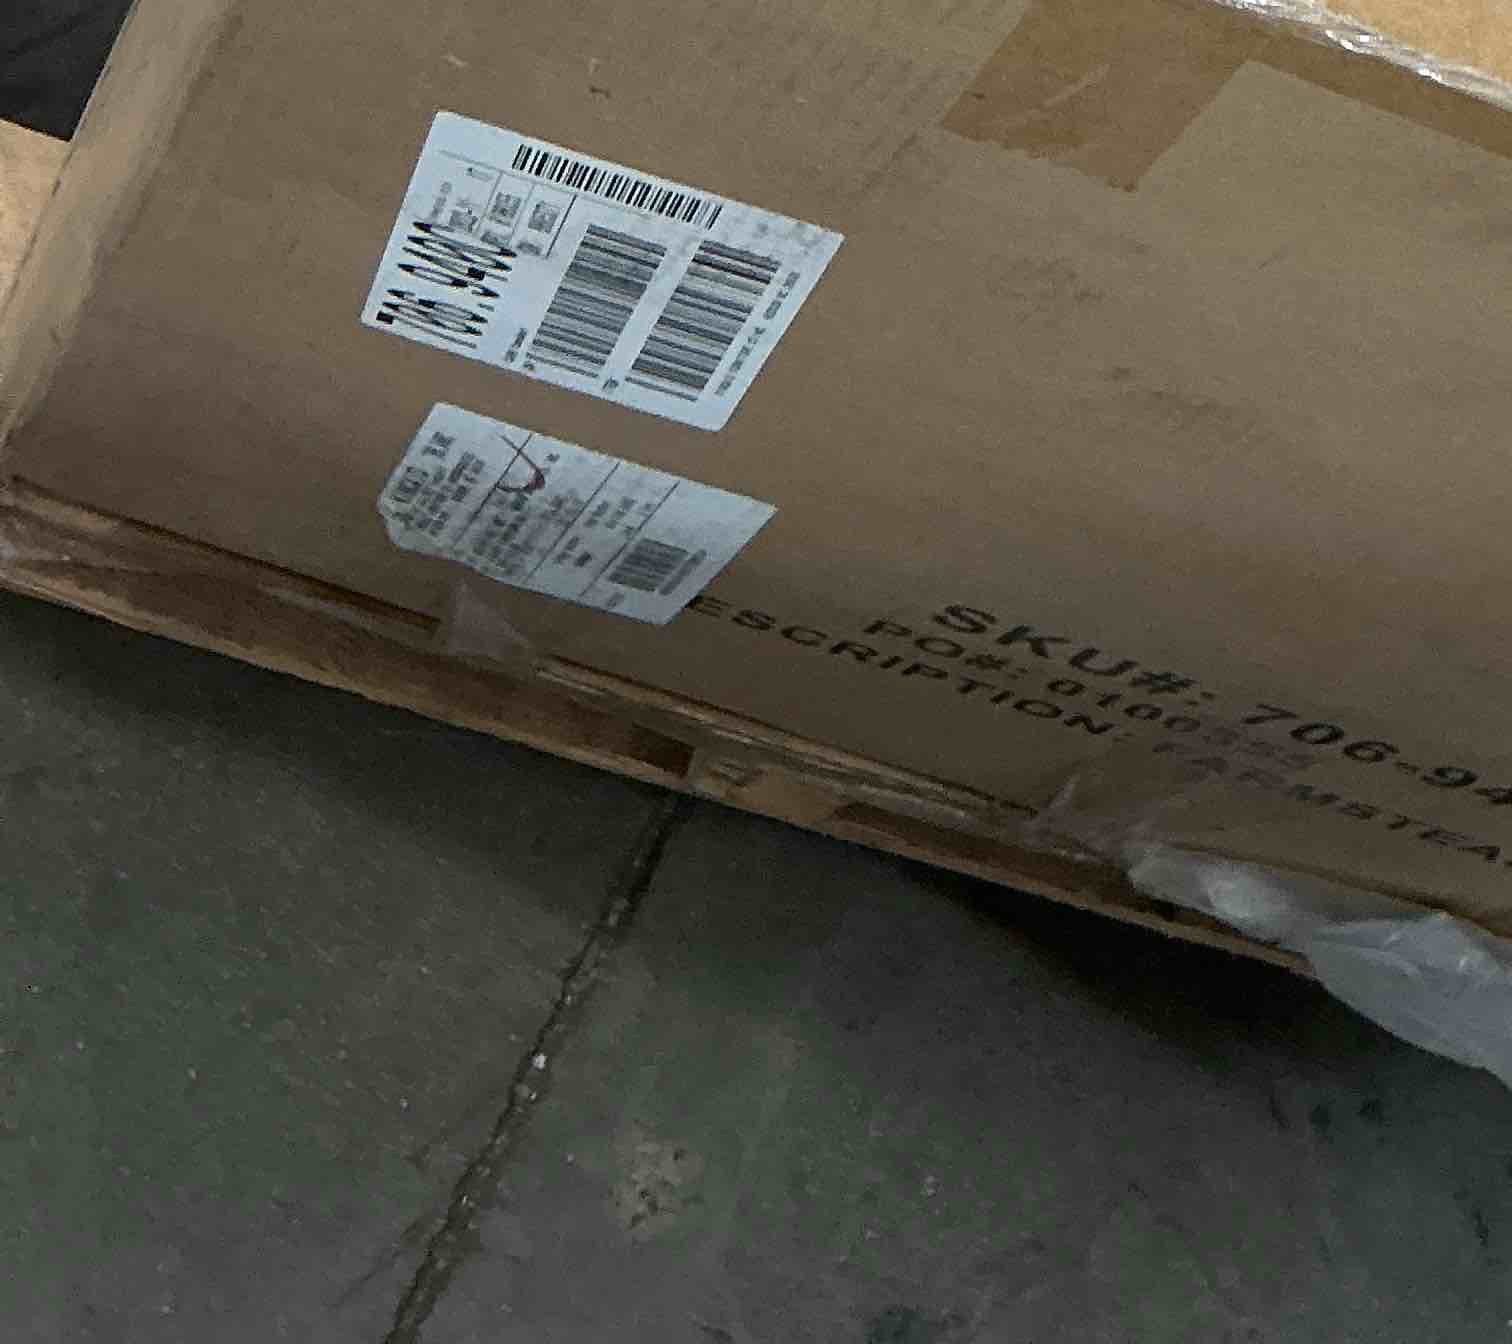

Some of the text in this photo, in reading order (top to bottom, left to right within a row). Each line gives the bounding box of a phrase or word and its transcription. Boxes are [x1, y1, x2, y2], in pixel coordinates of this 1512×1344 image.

[684, 595, 1134, 742] ESCRIPTION:
[863, 618, 1029, 679] PO#:
[932, 603, 1217, 706] SKU#:
